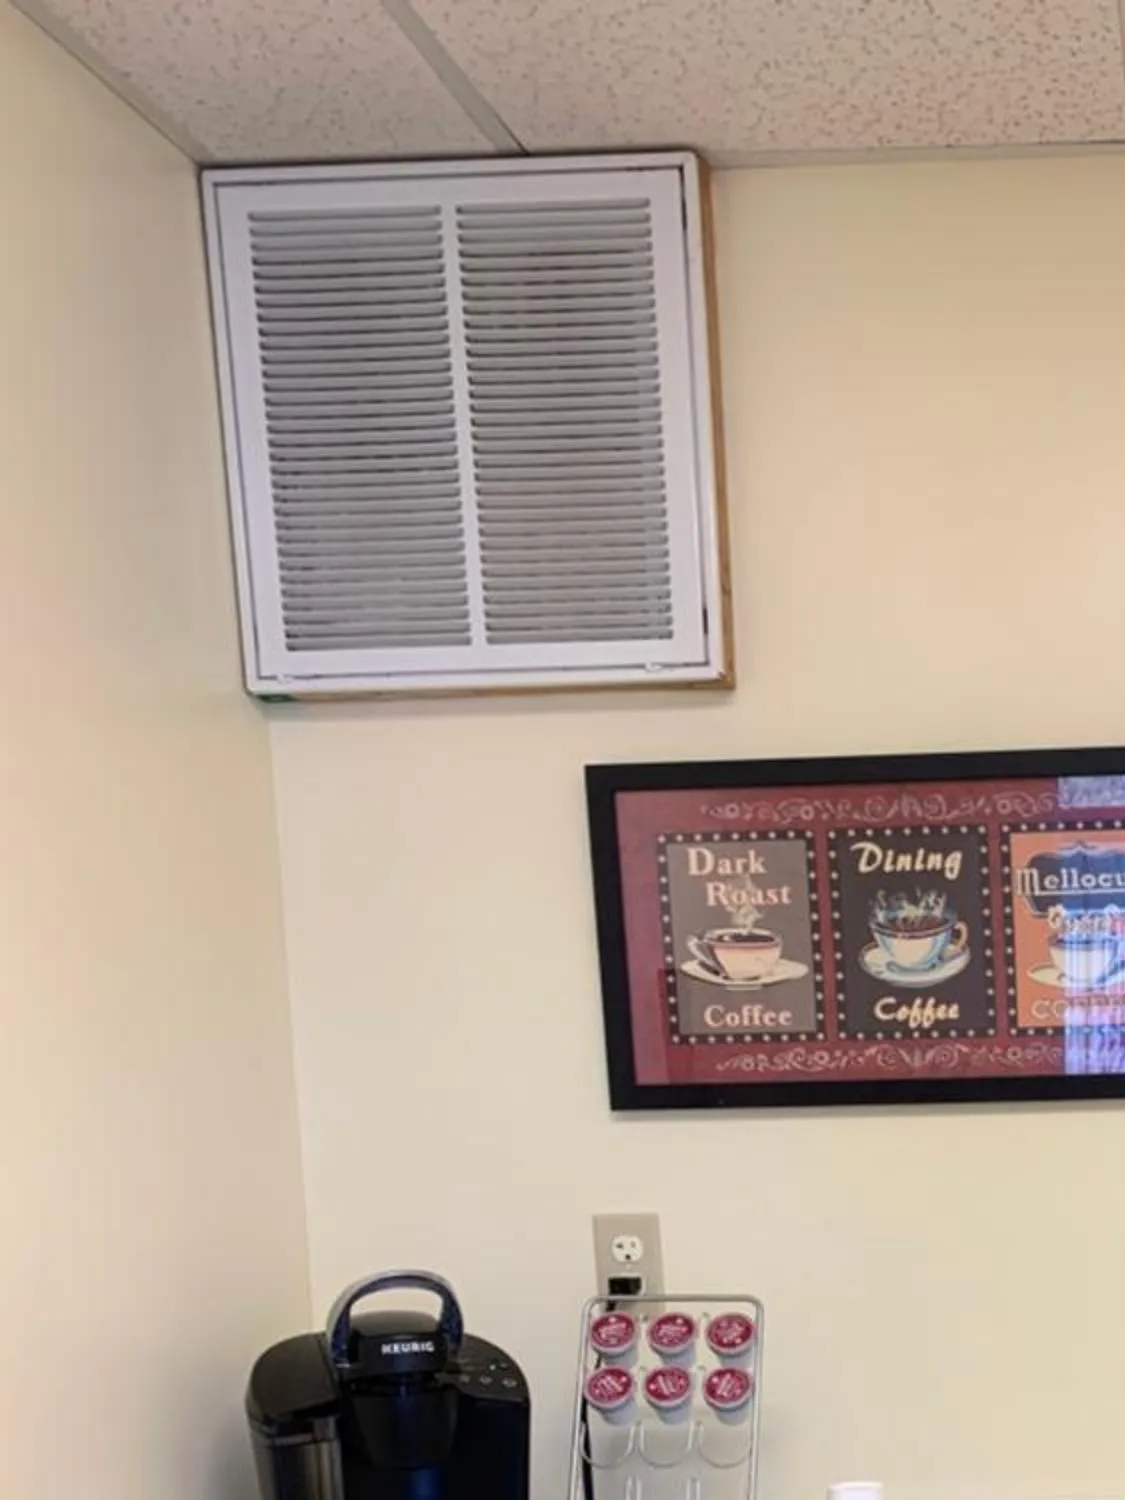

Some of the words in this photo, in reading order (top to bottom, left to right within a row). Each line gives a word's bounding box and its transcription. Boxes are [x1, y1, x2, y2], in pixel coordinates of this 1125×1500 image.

[687, 847, 767, 876] Dark
[850, 841, 963, 881] Dining
[705, 881, 792, 906] Roast
[703, 1005, 793, 1027] Coffee
[874, 996, 960, 1029] Coffee
[381, 1341, 435, 1354] KEURIG
